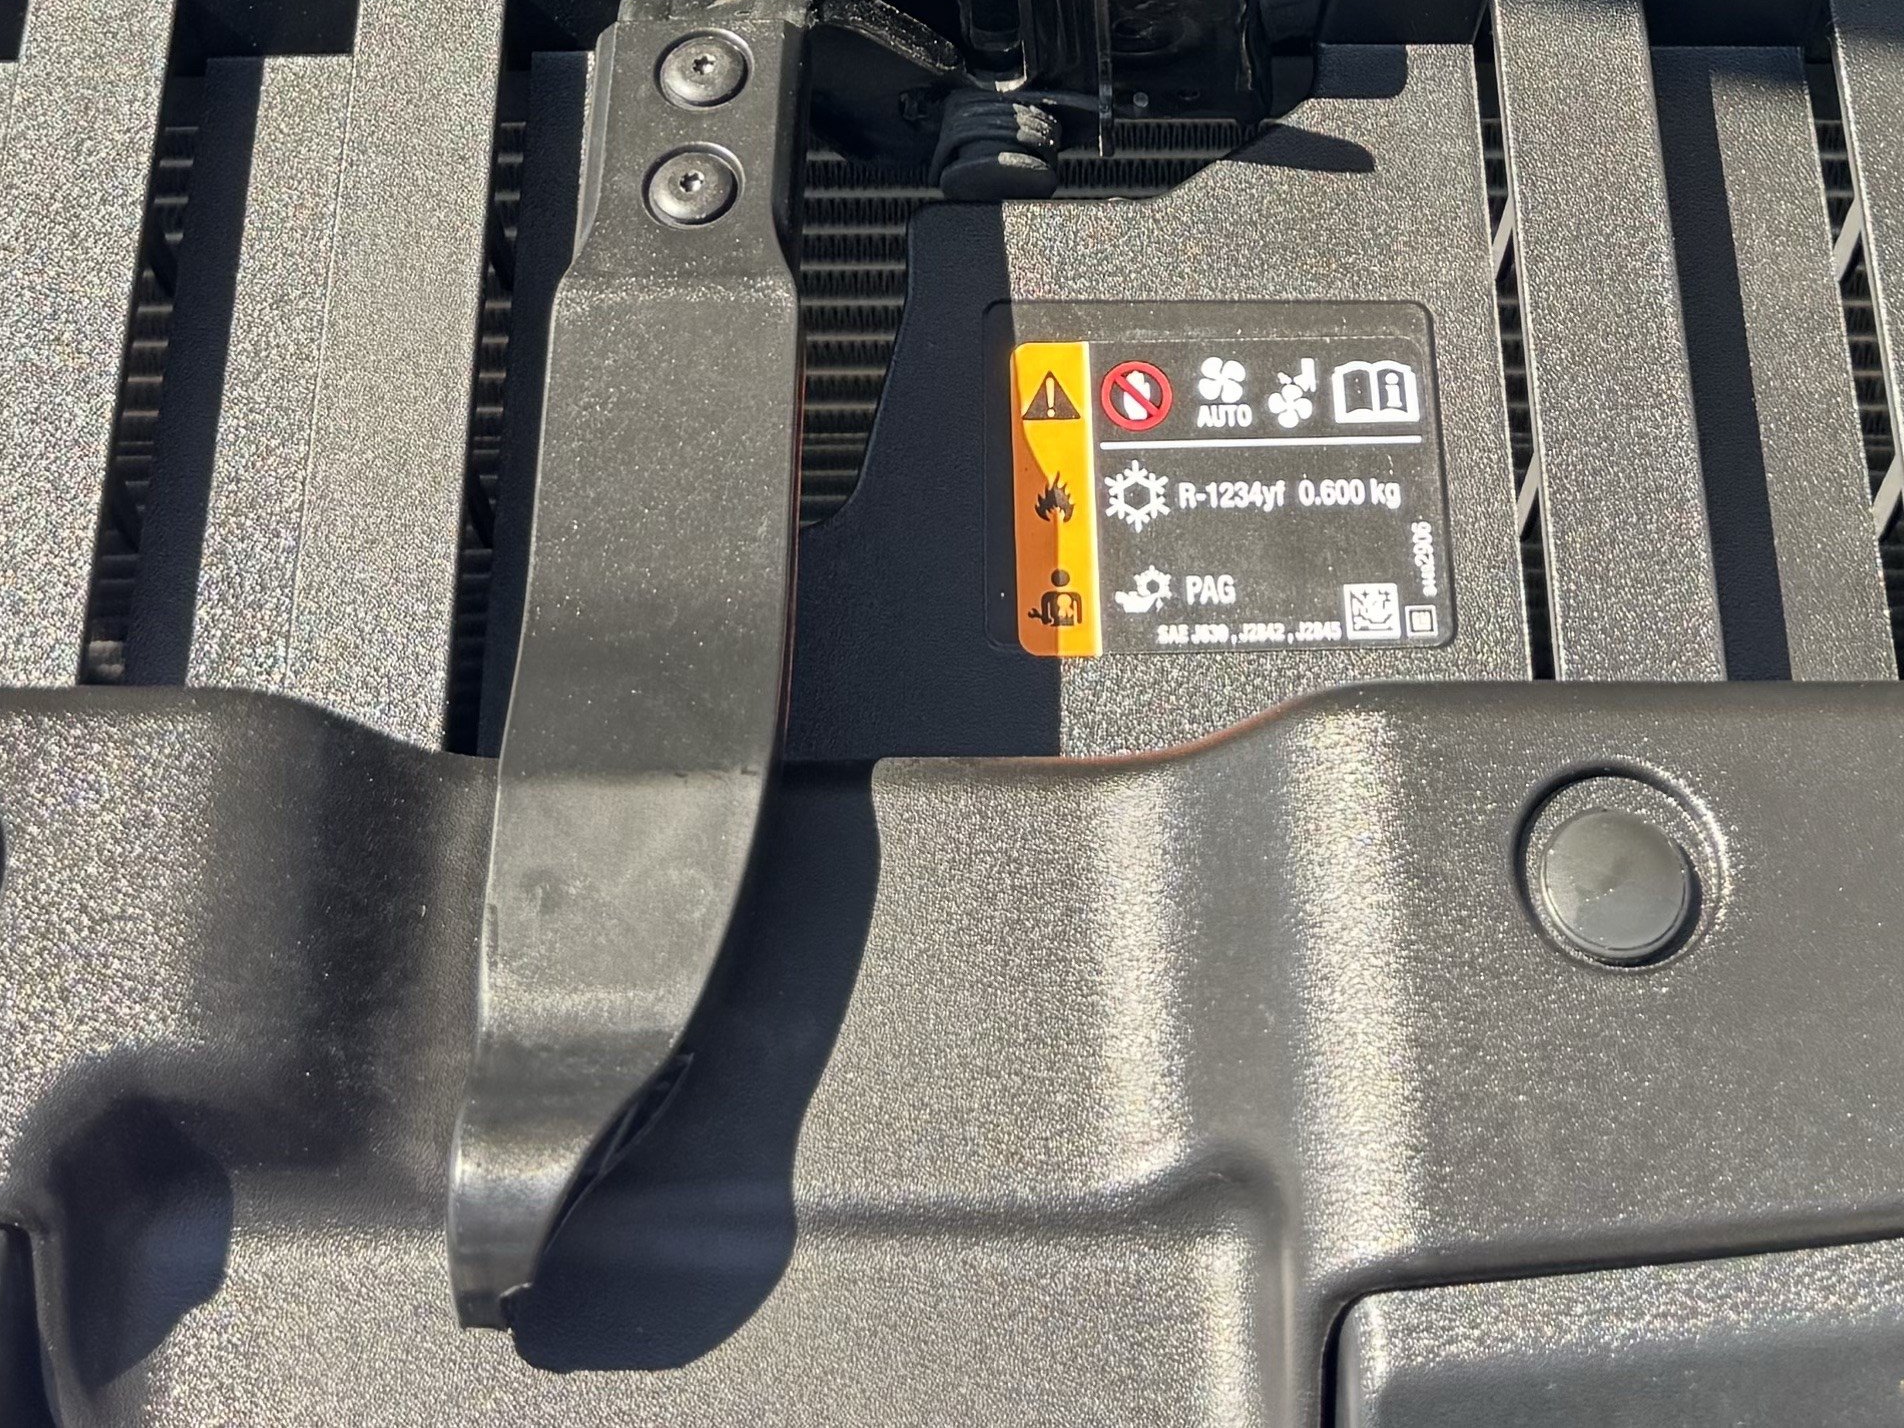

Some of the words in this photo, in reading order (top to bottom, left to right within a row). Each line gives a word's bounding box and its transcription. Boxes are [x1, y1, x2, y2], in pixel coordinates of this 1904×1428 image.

[1197, 403, 1253, 428] AUTO
[1178, 479, 1286, 512] R-1234yf
[1298, 478, 1366, 507] 0.600
[1369, 477, 1401, 510] kg
[1185, 574, 1237, 605] PAG
